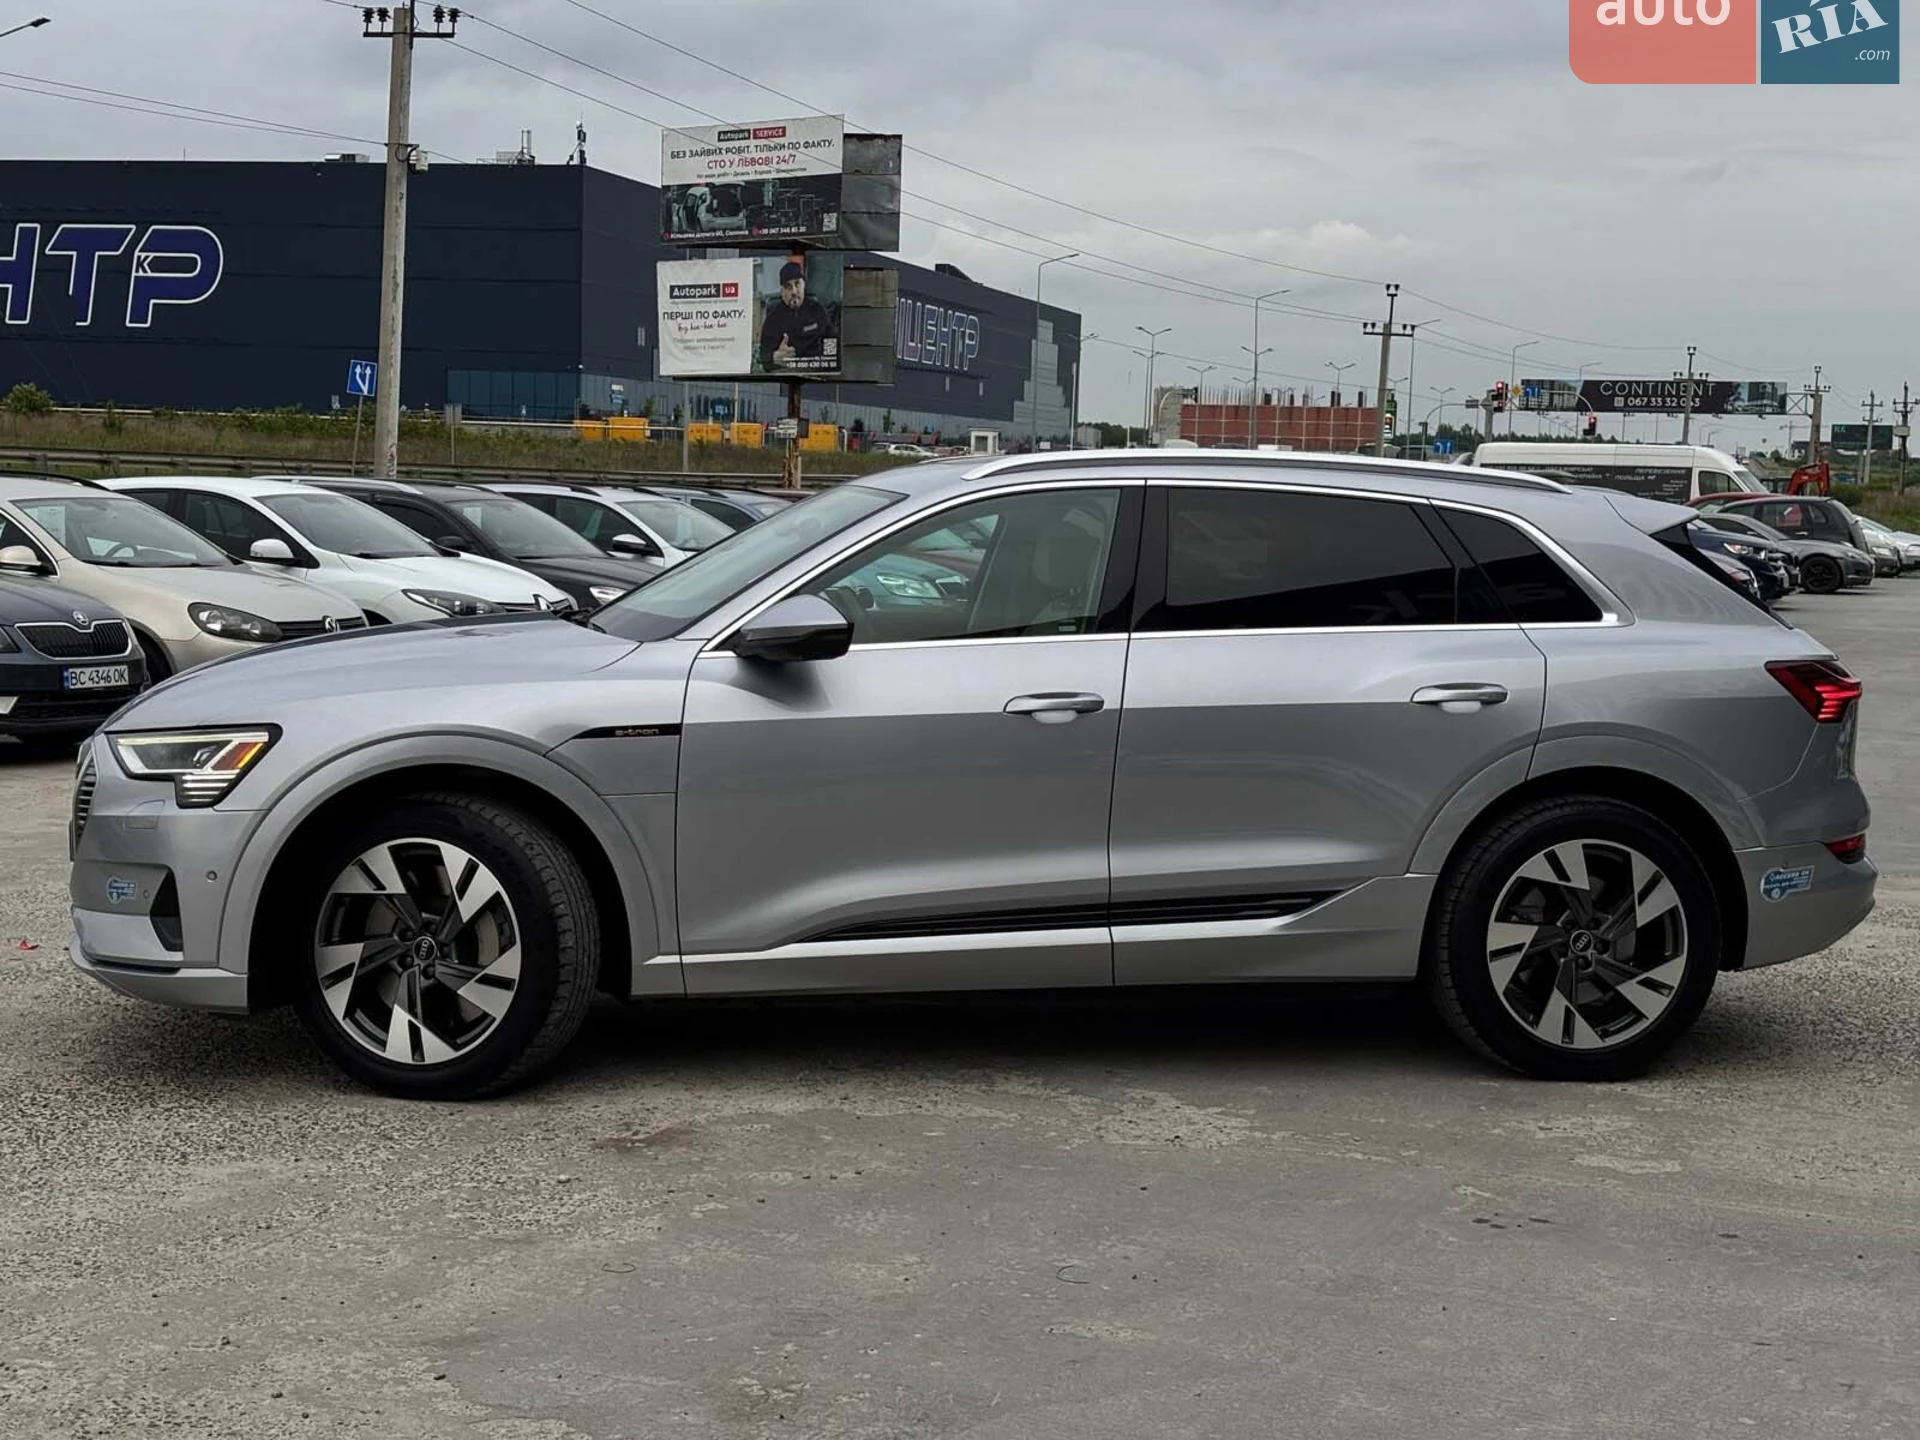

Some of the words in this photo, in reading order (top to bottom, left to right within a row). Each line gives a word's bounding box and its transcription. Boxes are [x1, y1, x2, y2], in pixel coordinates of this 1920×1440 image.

[719, 130, 749, 141] Autopark
[755, 128, 783, 138] SERVICE
[670, 150, 686, 159] БЕЗ
[688, 146, 723, 158] ЗАЙВИХ
[754, 143, 786, 154] ТІЛЬКИ
[787, 141, 801, 151] ПО
[802, 138, 835, 150] ФАКТУ.
[707, 159, 727, 170] СТО
[728, 158, 735, 168] У
[736, 156, 774, 168] ЛЬВОВІ
[775, 154, 797, 165] 24/7
[672, 284, 717, 298] Autopark
[725, 286, 736, 295] ua
[662, 311, 693, 321] ПЕРШІ
[695, 310, 710, 320] ПО
[712, 309, 746, 319] ФАКТУ.
[1600, 381, 1717, 396] CONTINENT
[1627, 396, 1646, 407] 067
[1664, 396, 1678, 407] 32
[1679, 397, 1700, 407] 03
[70, 669, 86, 686] BC
[88, 669, 112, 685] 4346
[113, 667, 127, 684] OK
[614, 728, 660, 736] e-tron
